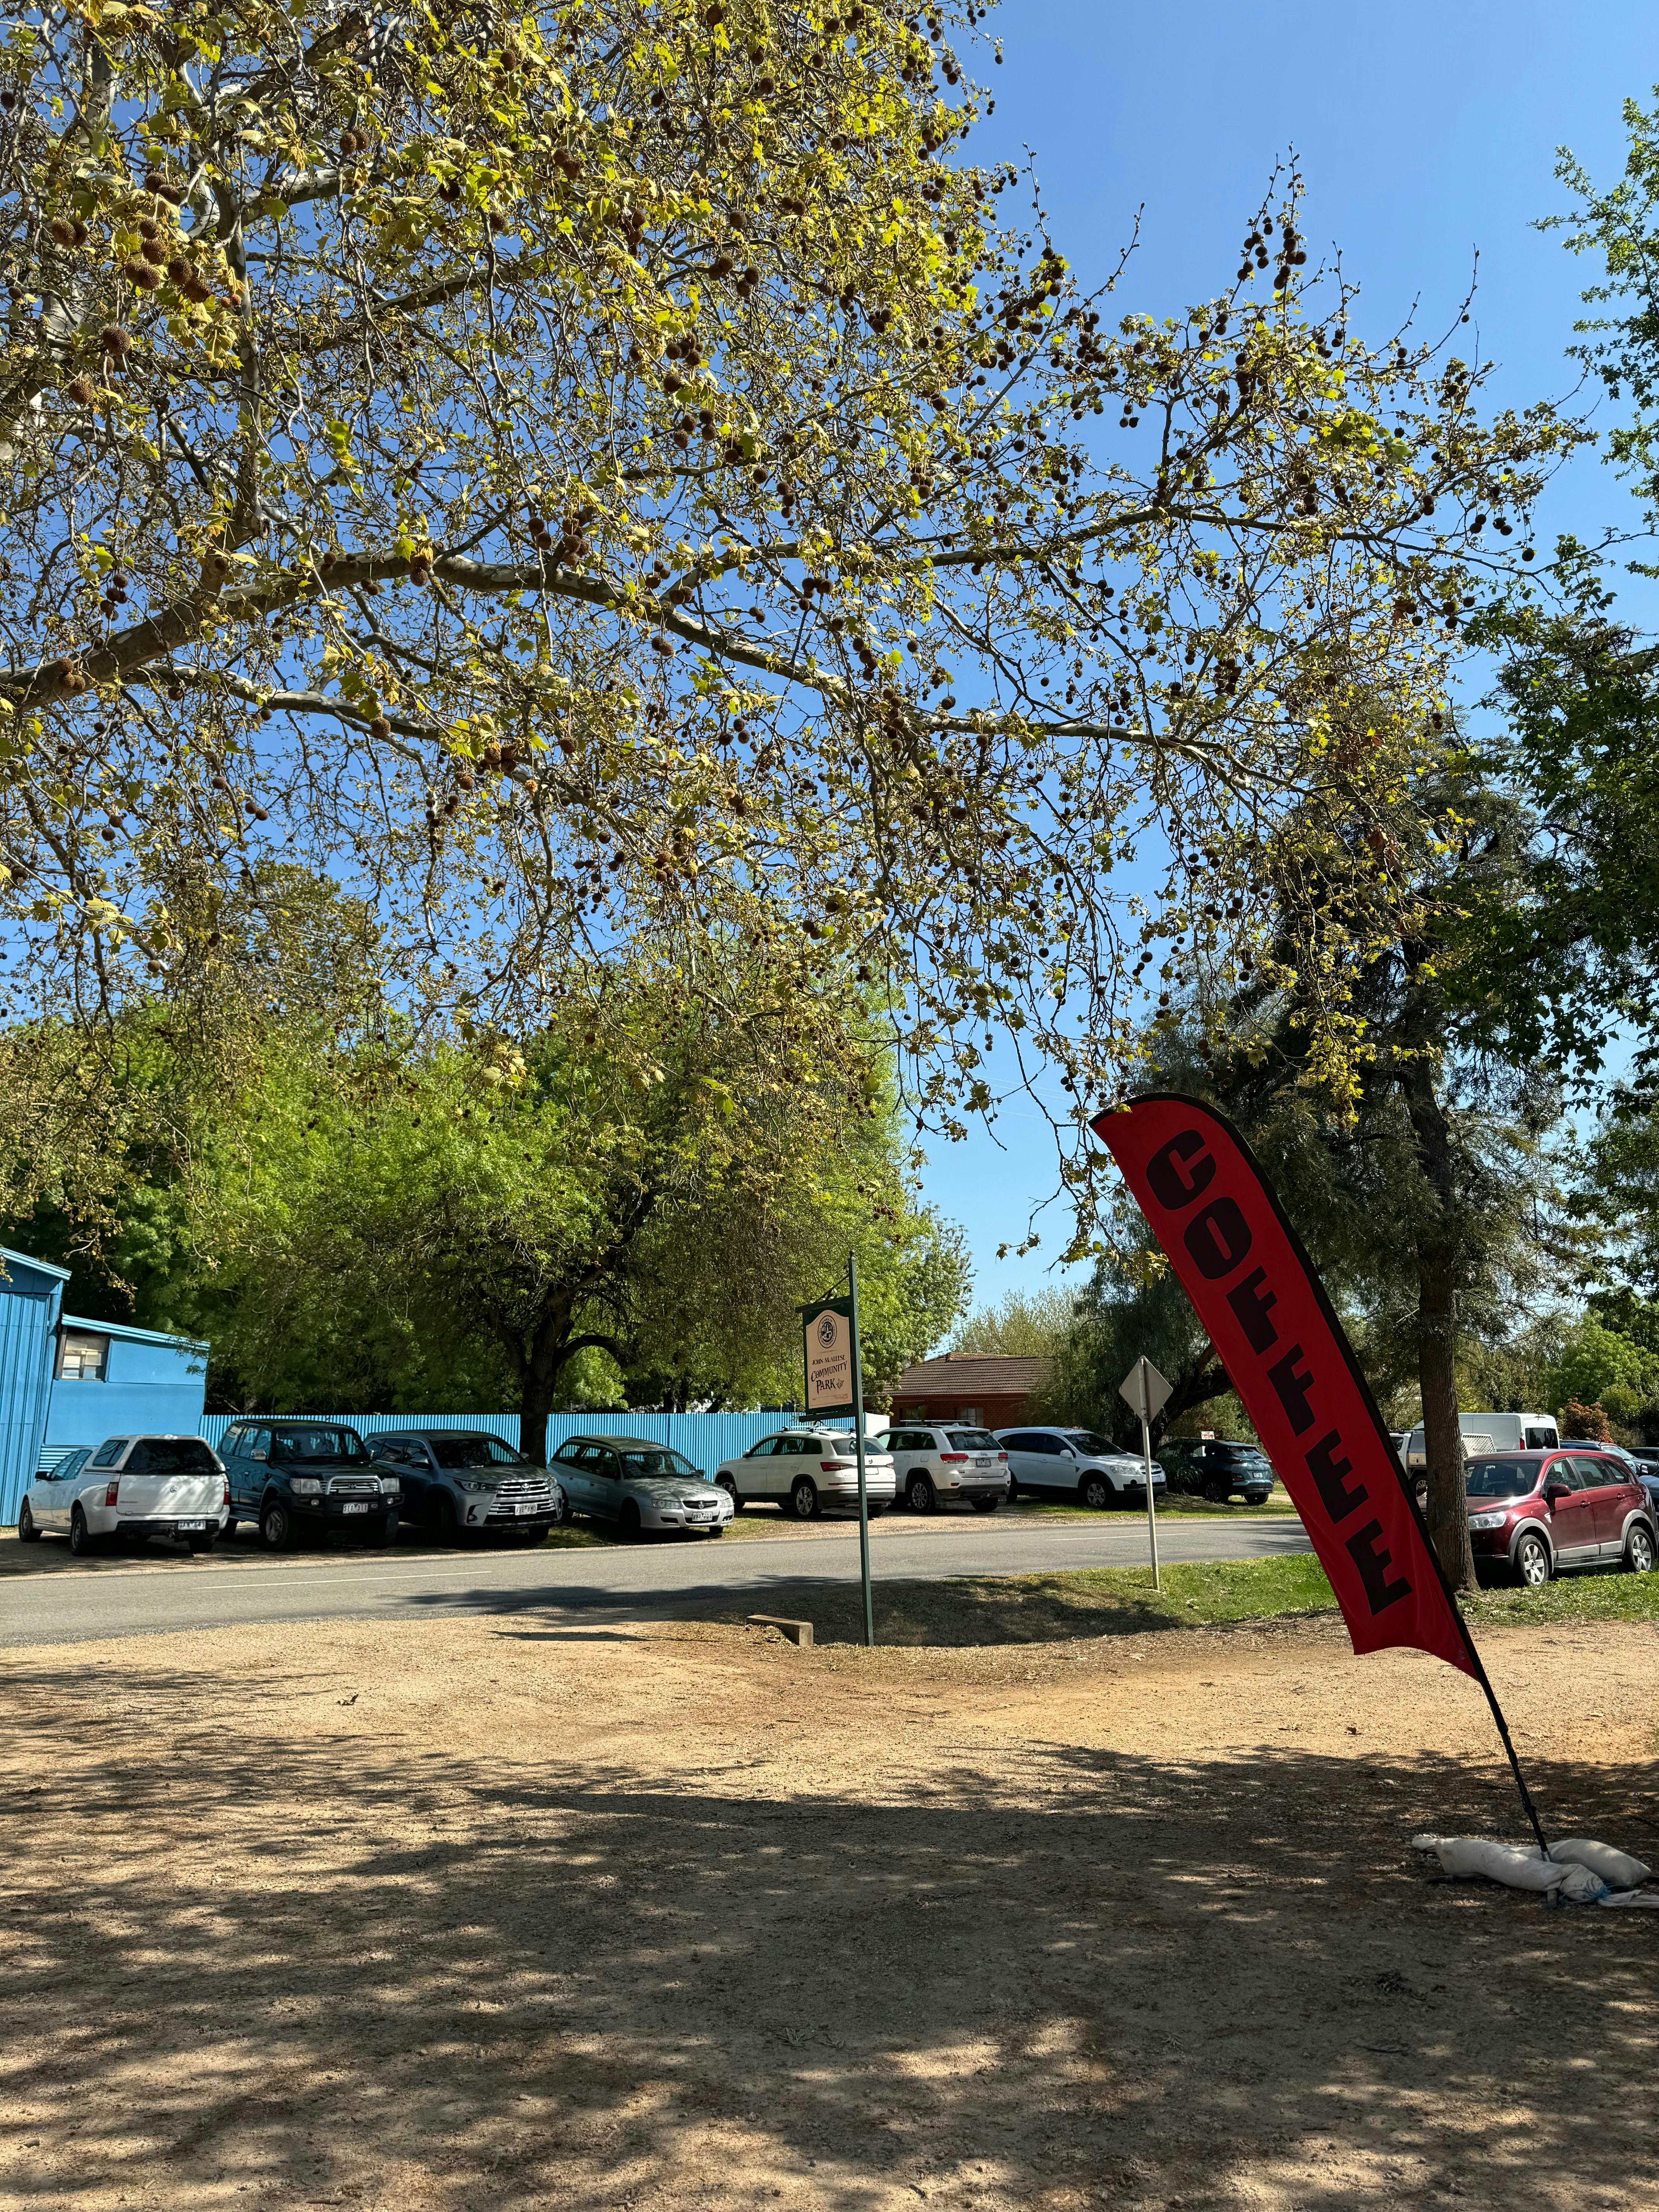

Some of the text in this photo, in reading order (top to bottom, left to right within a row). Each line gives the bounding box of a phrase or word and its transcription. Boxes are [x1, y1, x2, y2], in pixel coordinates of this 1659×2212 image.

[811, 1360, 847, 1382] COMMUNITY
[1146, 1129, 1411, 1616] COFFEE
[816, 1378, 836, 1394] PARK
